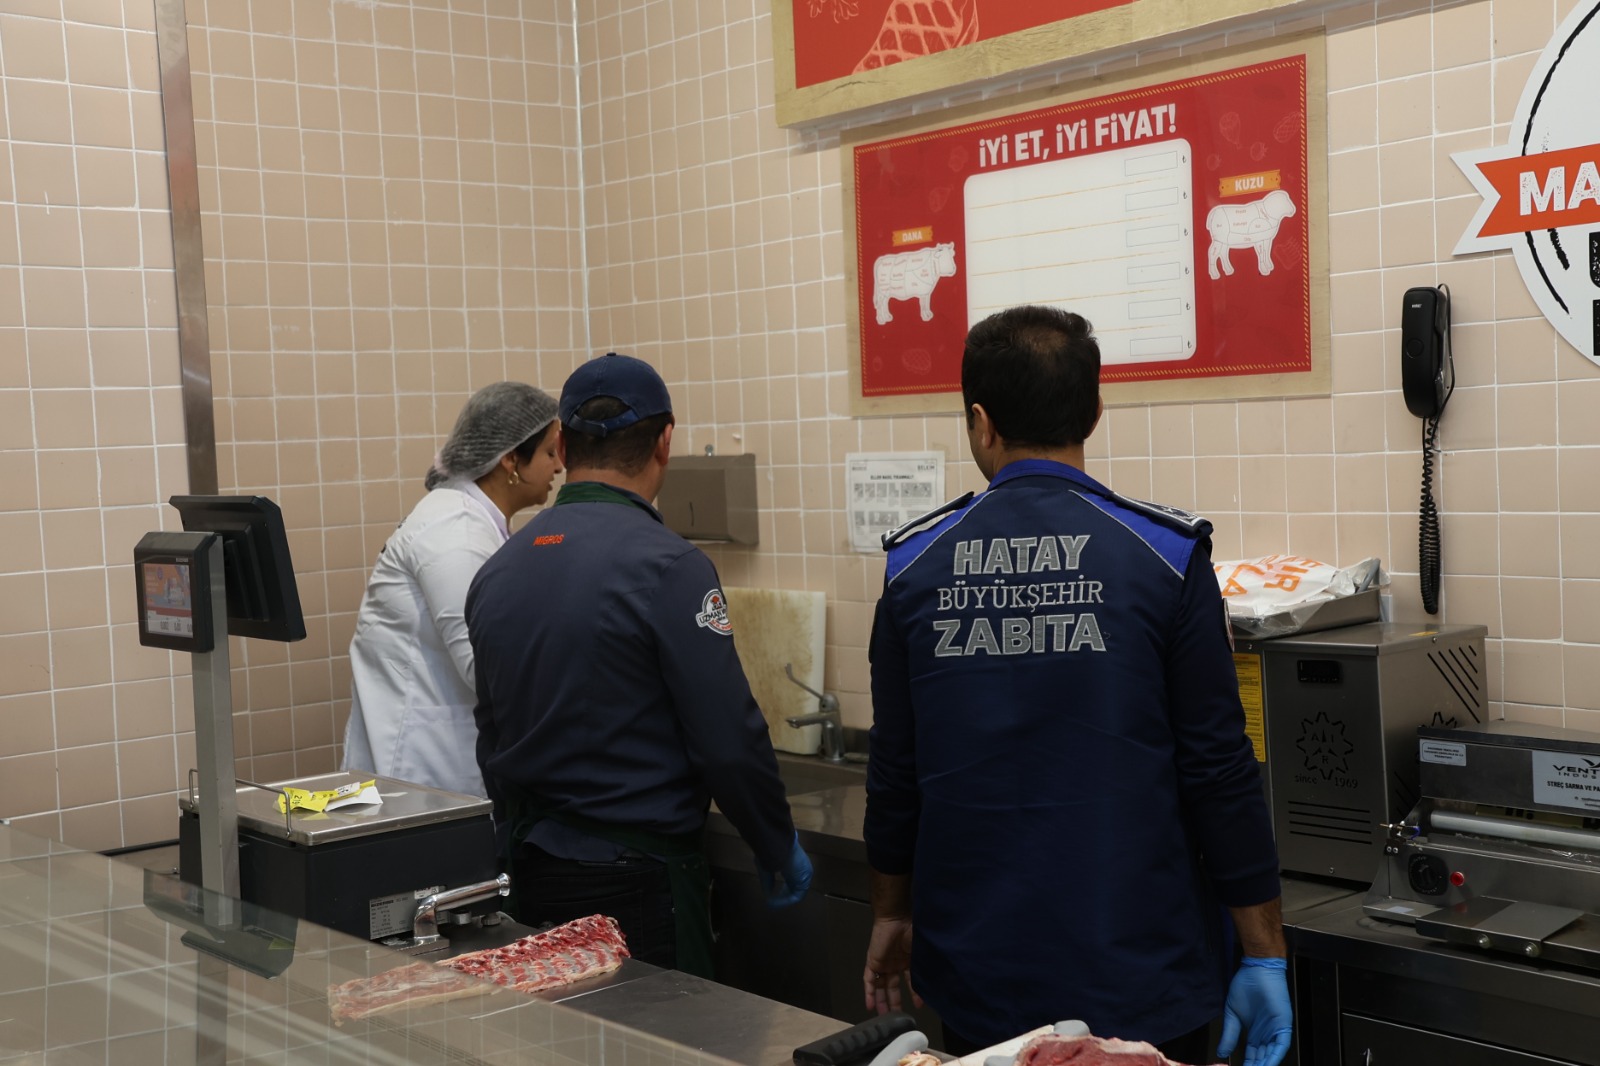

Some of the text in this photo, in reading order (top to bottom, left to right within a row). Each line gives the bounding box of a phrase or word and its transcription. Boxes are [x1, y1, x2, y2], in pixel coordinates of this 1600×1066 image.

[1014, 129, 1050, 160] ET,
[1235, 176, 1264, 192] KUZU
[902, 230, 923, 242] DANA
[533, 534, 565, 546] MIGROS
[953, 534, 1091, 575] HATAY
[937, 574, 1104, 612] BÜYÜKŞEHİR
[932, 613, 1107, 657] ZABITA
[1295, 773, 1358, 789] since 1969
